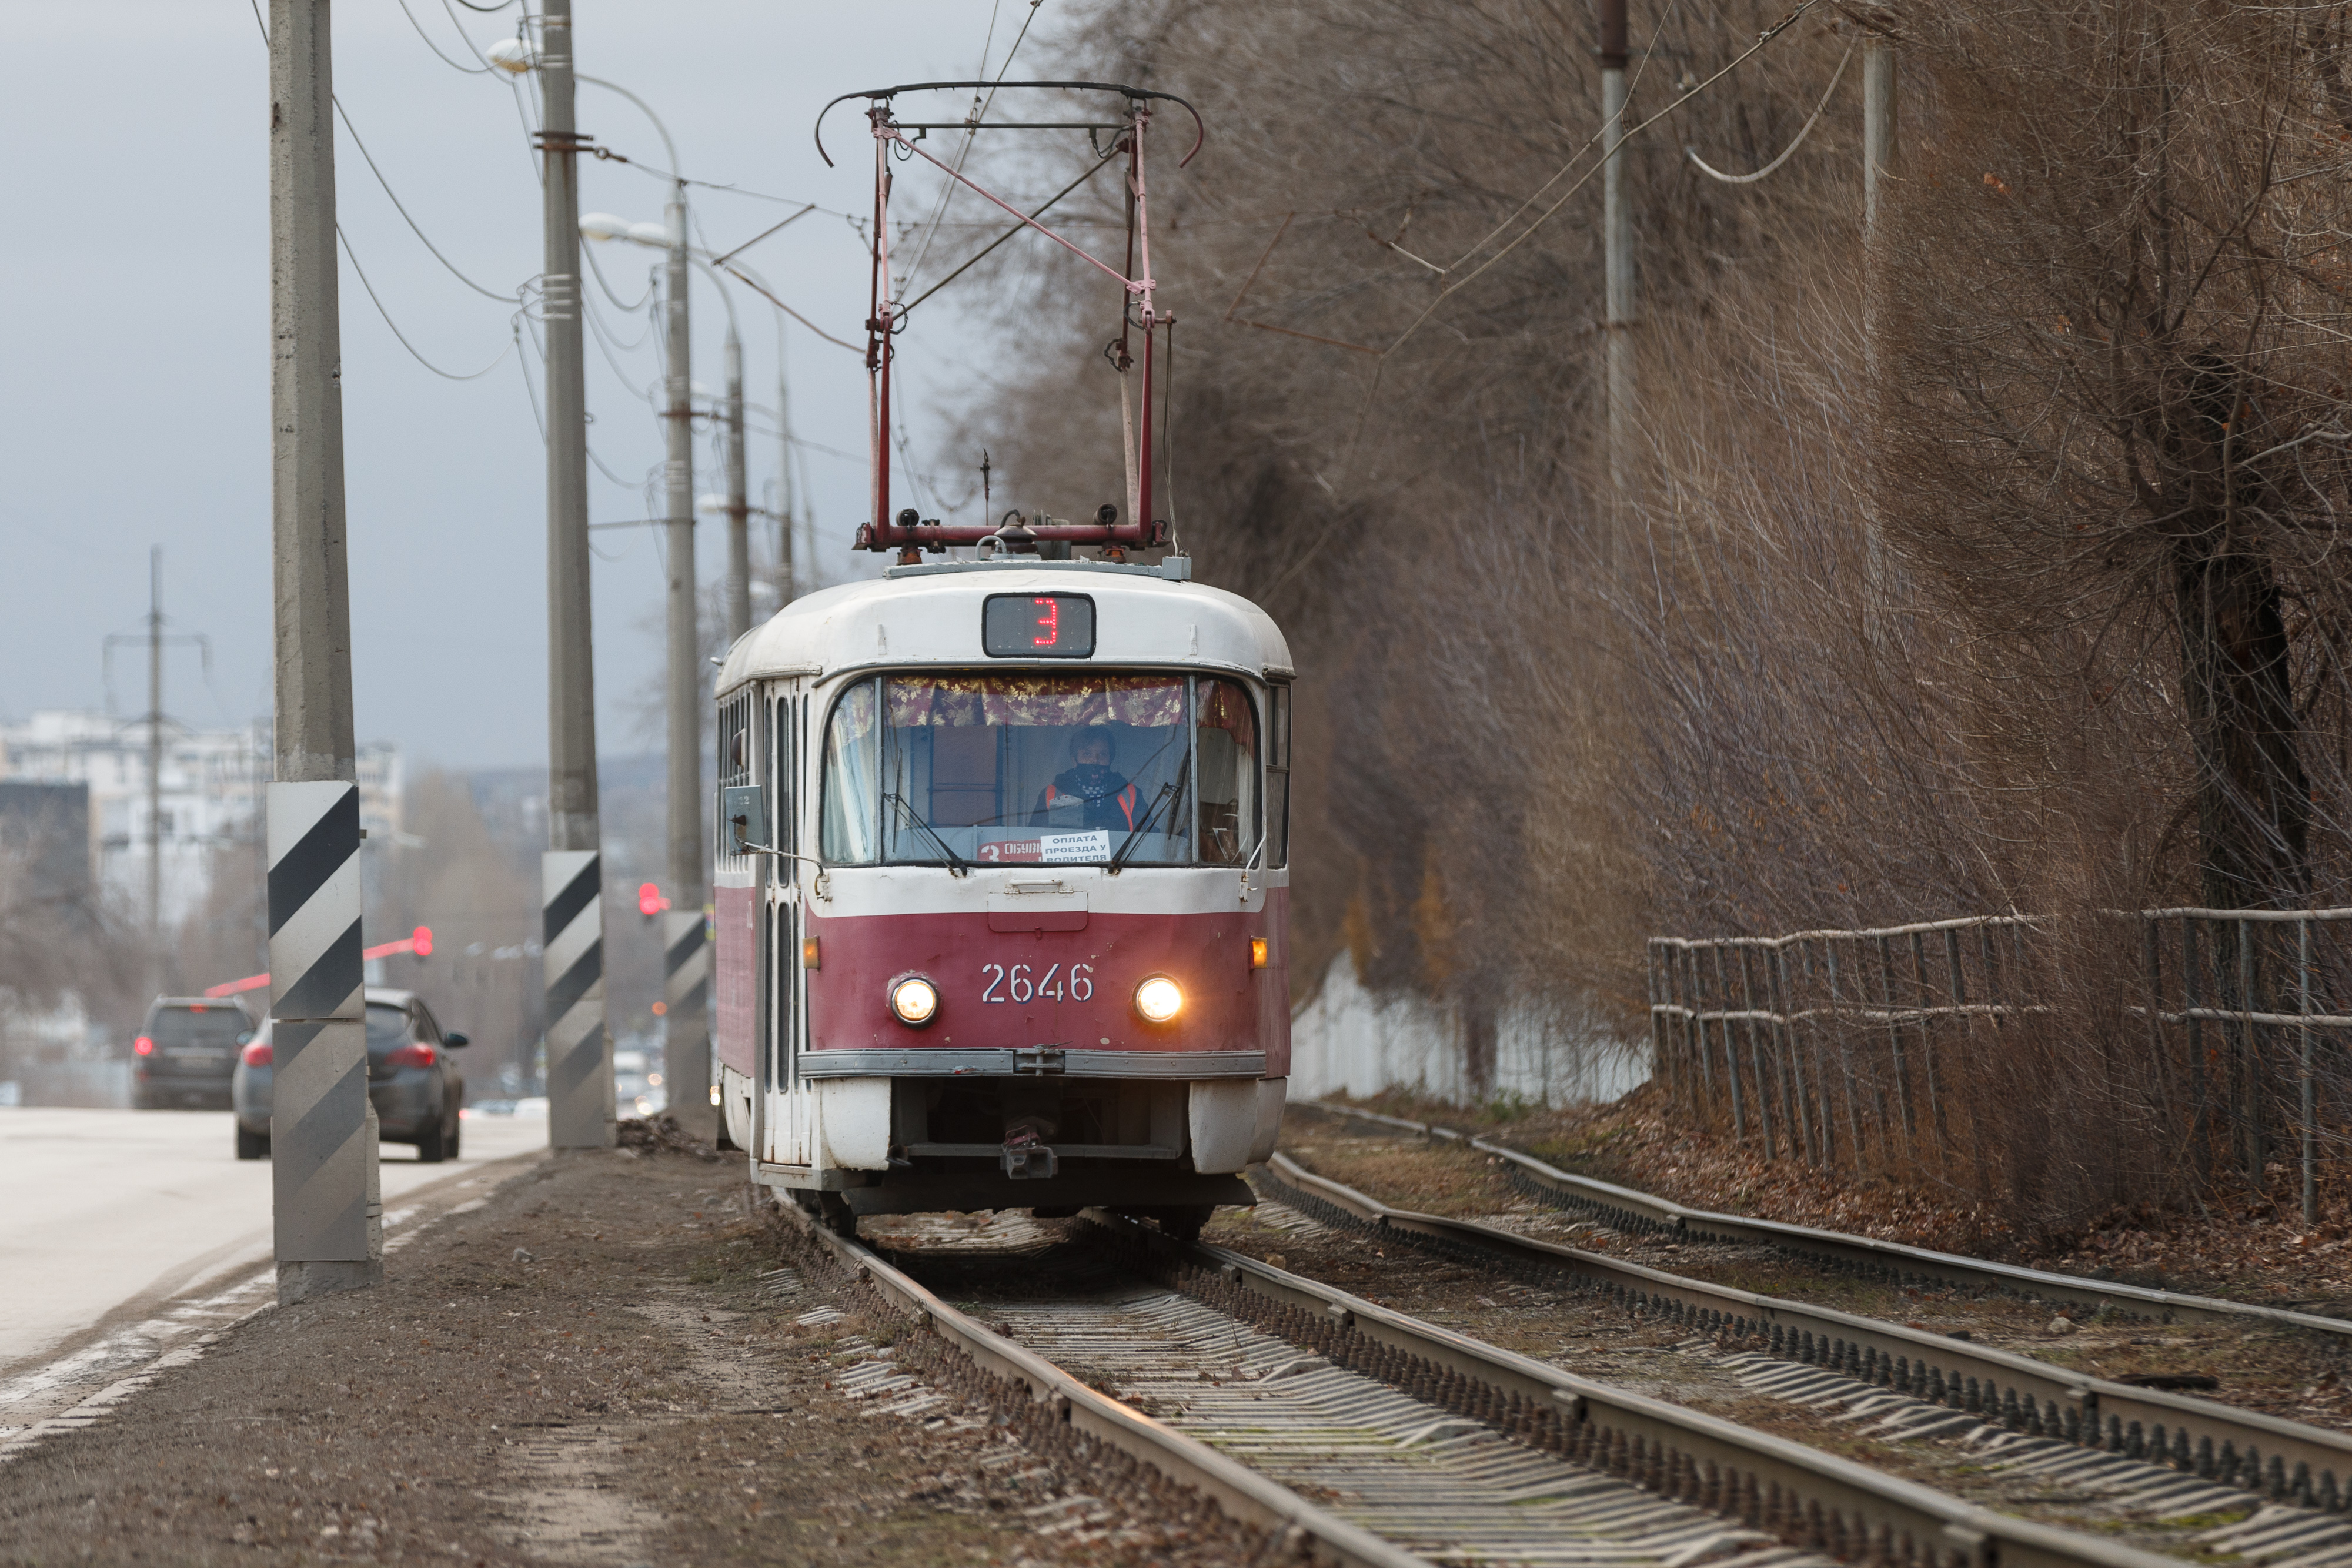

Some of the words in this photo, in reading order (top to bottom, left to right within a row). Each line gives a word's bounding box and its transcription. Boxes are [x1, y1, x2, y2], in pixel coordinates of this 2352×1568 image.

[1035, 598, 1057, 644] 3
[1052, 835, 1098, 844] ОПЛАТА
[981, 845, 1000, 862] 3
[1045, 845, 1097, 854] ПРОЕЗДА
[1047, 854, 1107, 862] ВОДИТЕЛЯ
[982, 964, 1093, 1003] 2646
